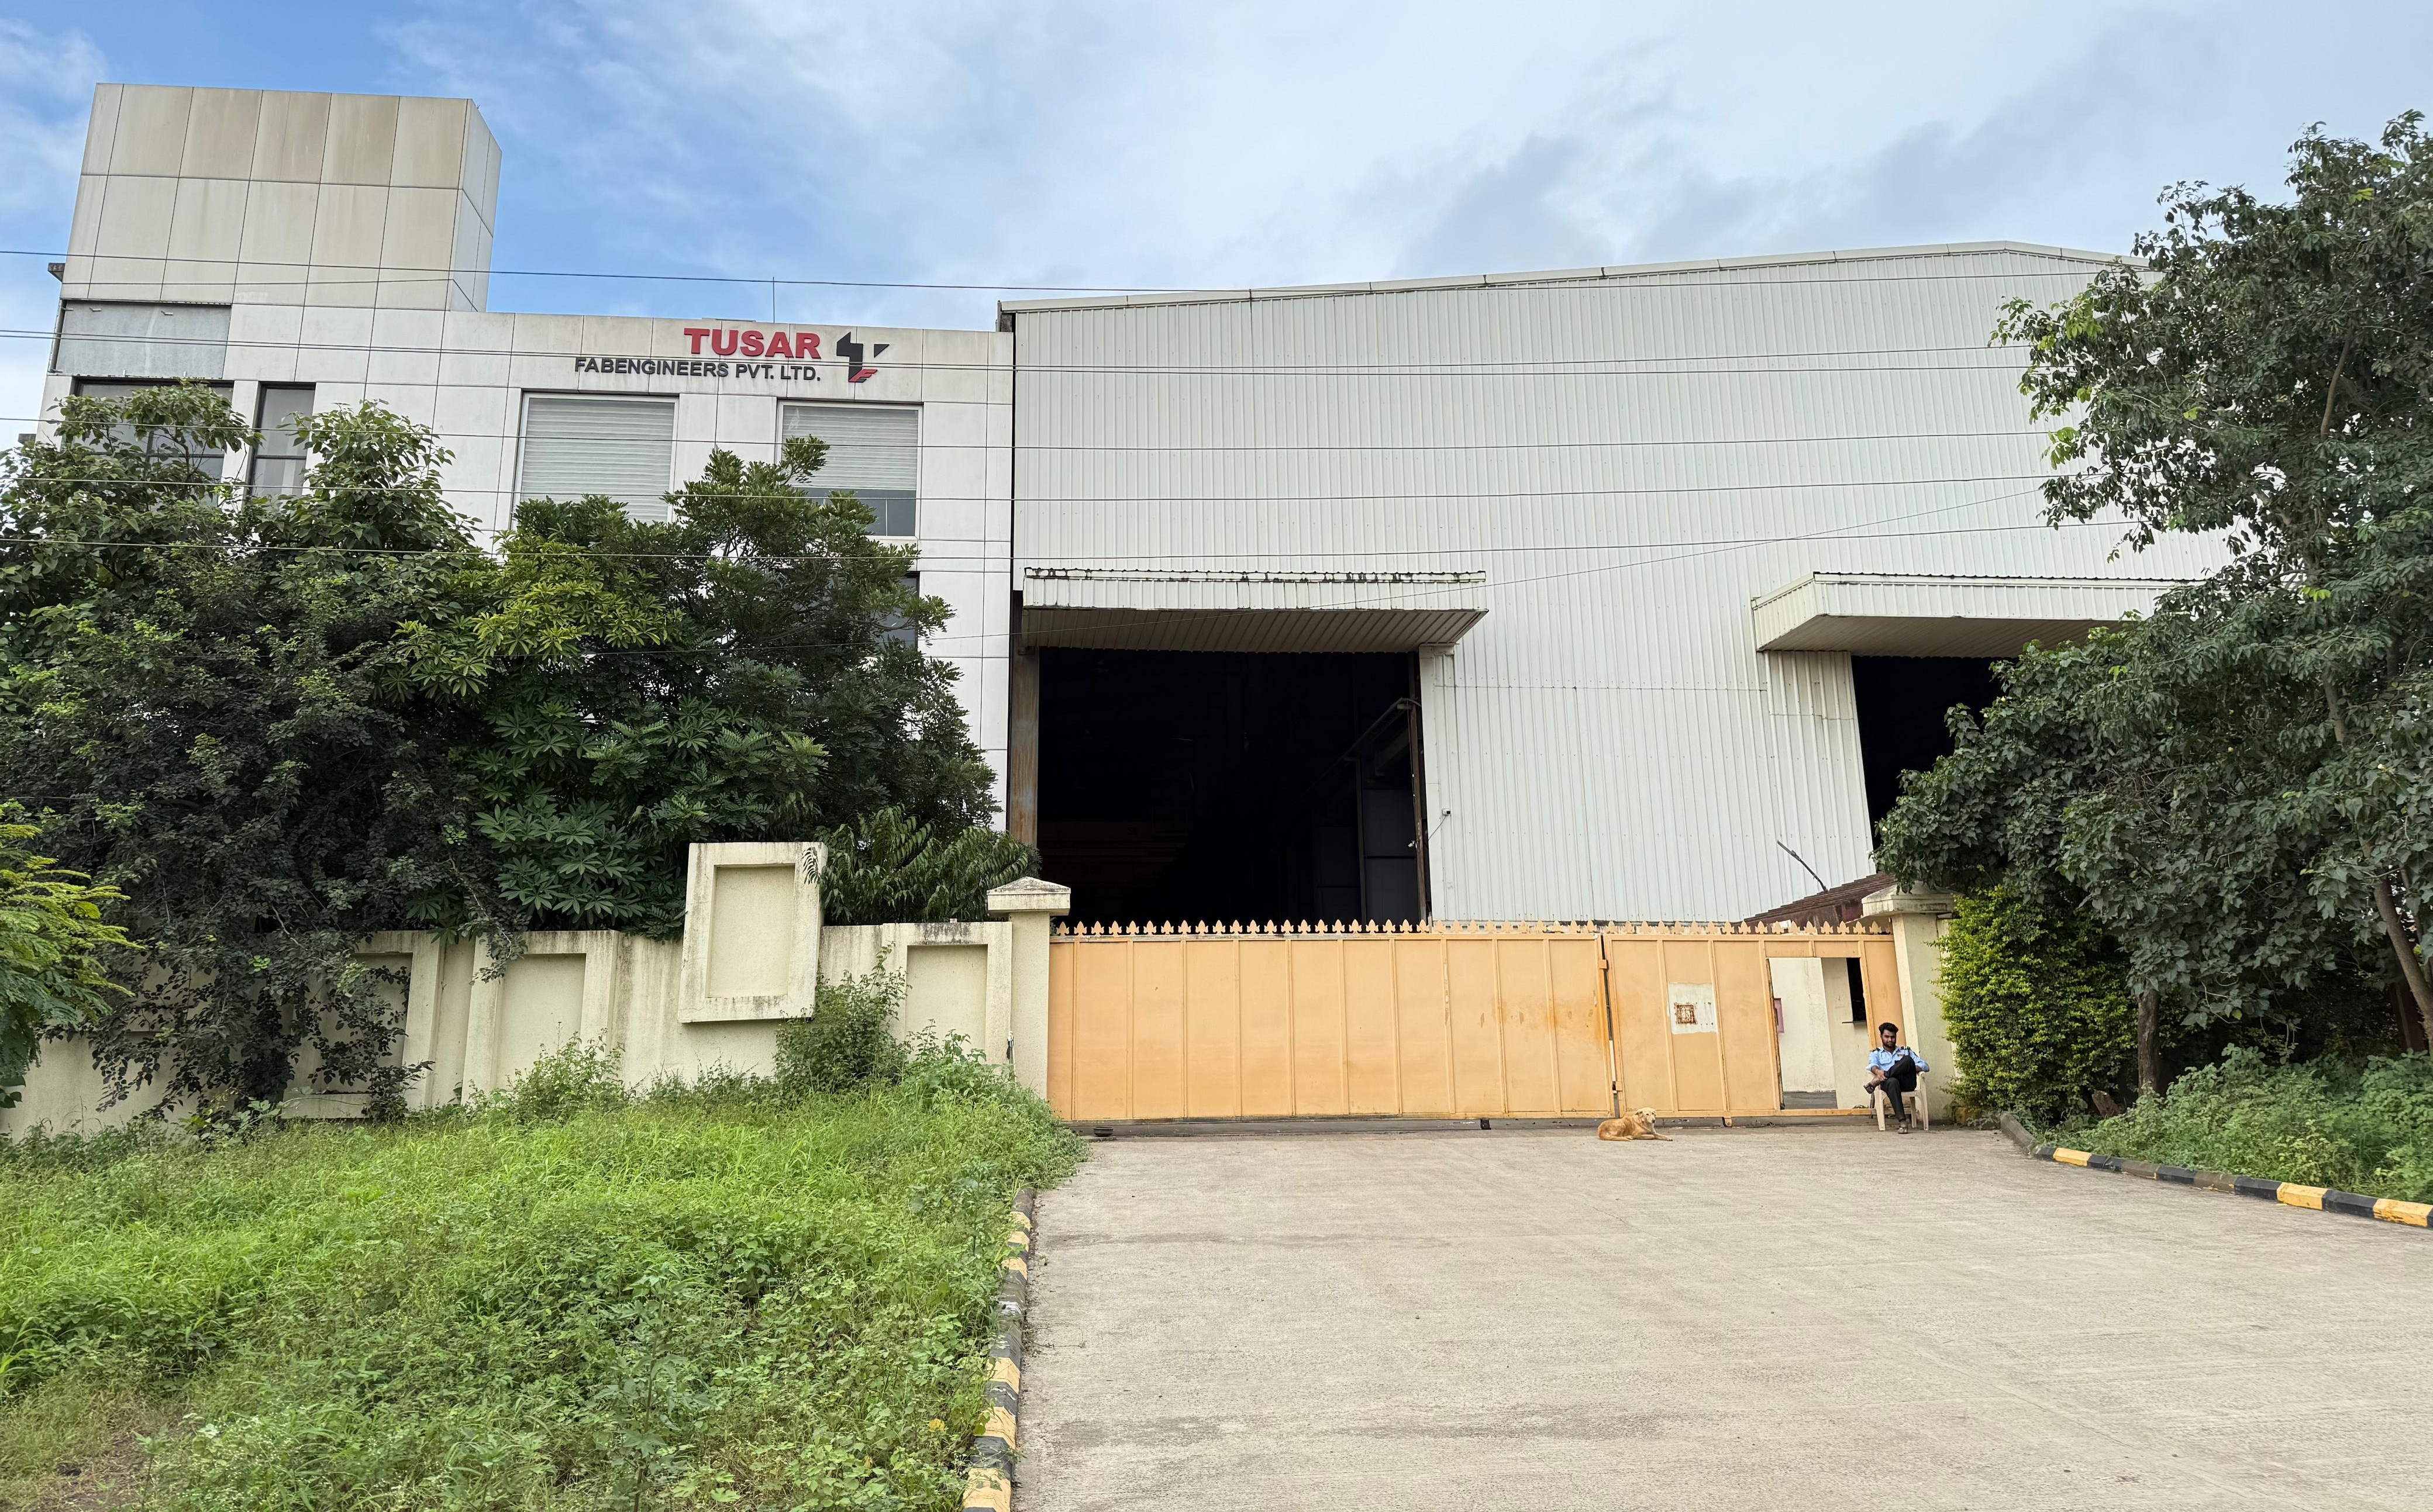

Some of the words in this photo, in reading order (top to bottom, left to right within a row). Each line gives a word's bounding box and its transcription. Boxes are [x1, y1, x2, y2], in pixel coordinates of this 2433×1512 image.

[684, 327, 821, 359] TUSAR
[574, 357, 729, 377] FABENGINEERS
[735, 363, 774, 379] PVT.
[780, 365, 821, 382] LTD.
